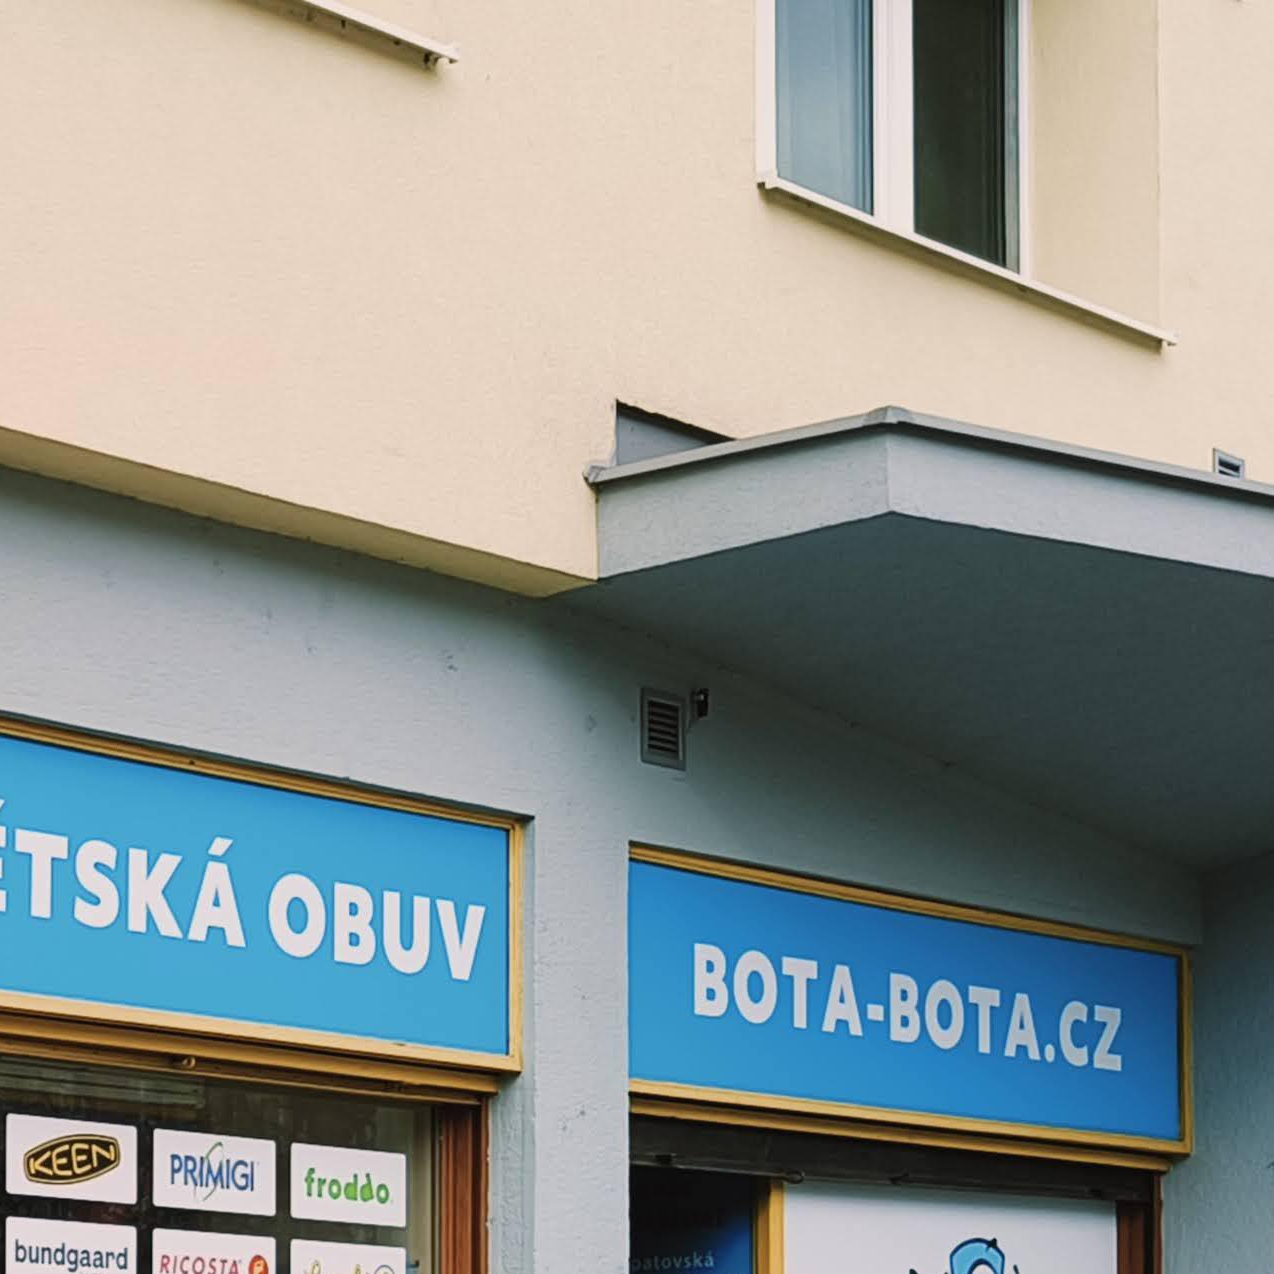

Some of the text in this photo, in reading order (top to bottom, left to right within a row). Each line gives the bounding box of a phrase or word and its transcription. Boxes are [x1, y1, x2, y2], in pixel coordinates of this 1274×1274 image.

[268, 873, 486, 981] OBUV
[693, 943, 1122, 1071] BOTA-BOTA.CZ
[29, 1143, 115, 1176] KEEN
[170, 1148, 255, 1194] PRIMIGI
[304, 1168, 390, 1204] froddo
[15, 1239, 128, 1273] bundgaard
